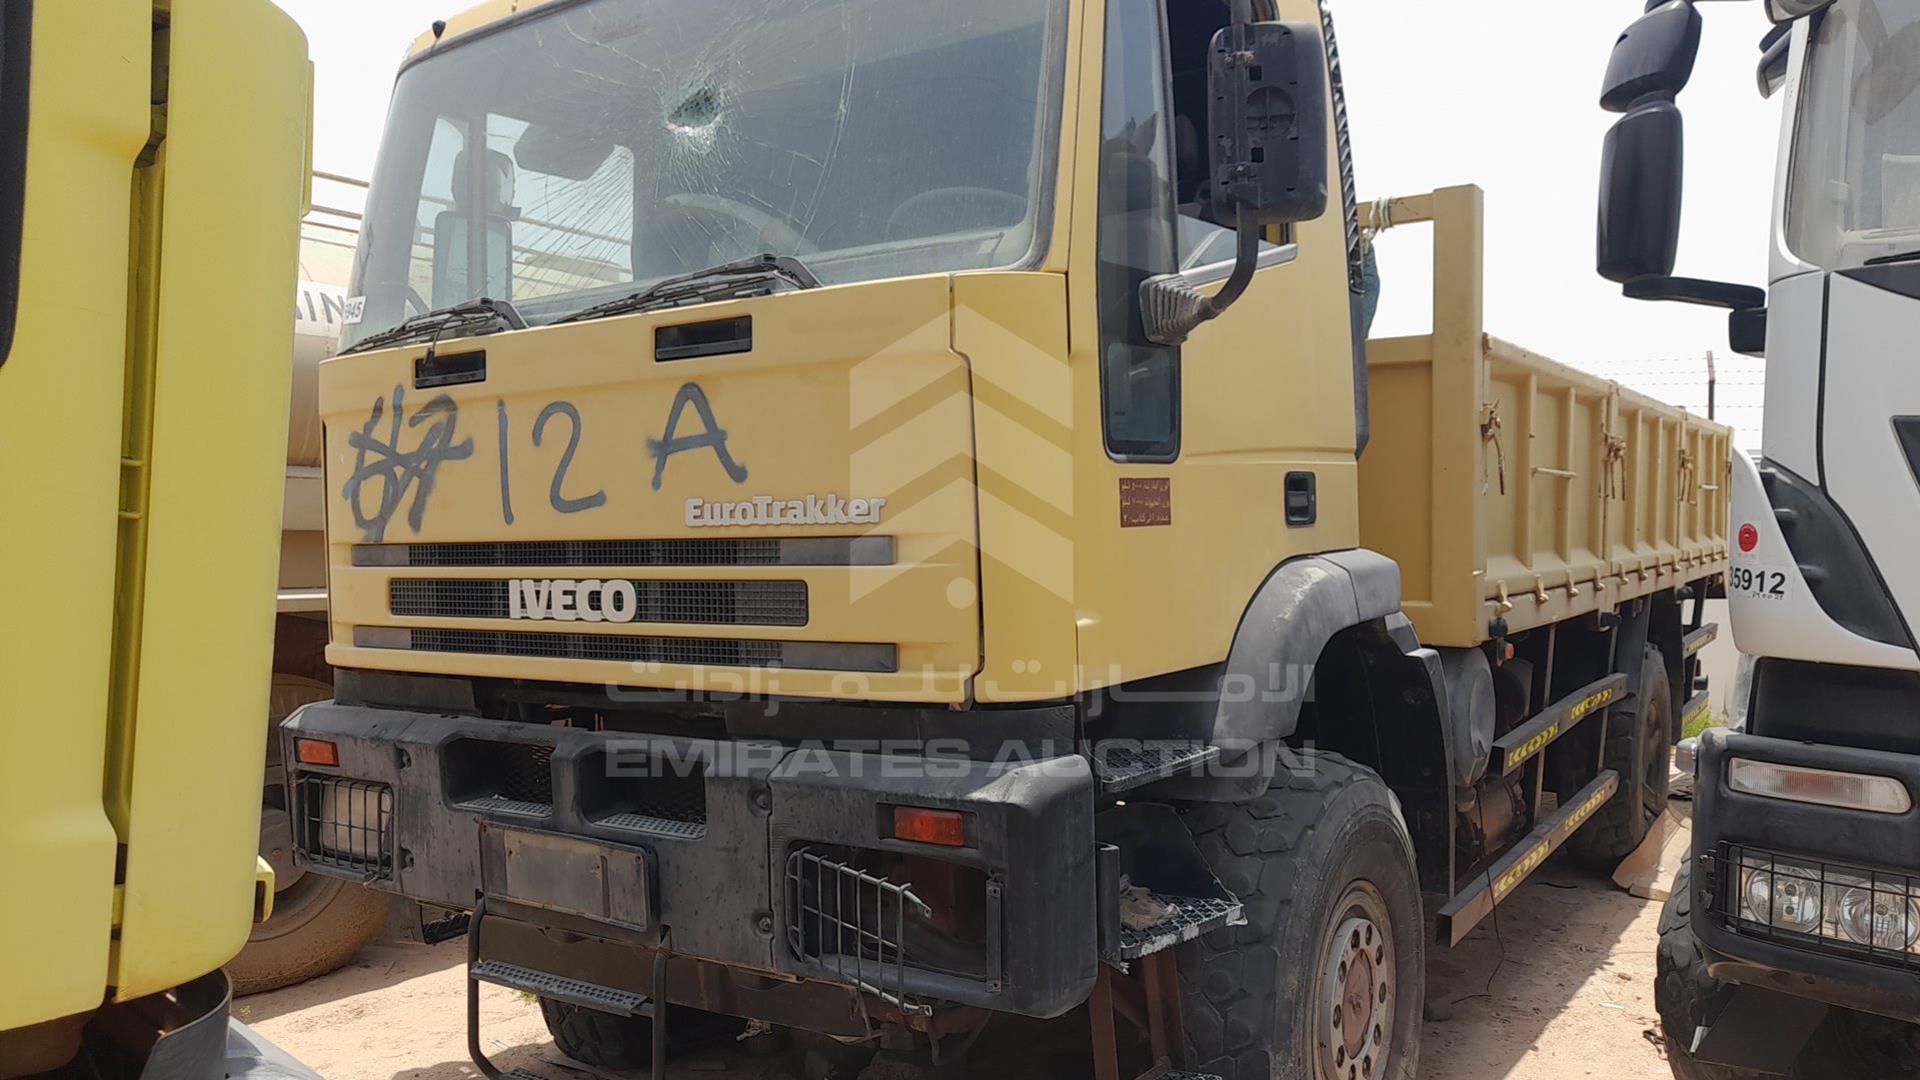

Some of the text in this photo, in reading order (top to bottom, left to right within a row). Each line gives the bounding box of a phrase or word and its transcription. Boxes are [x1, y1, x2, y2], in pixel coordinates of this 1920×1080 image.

[647, 382, 749, 491] A
[684, 494, 886, 526] EuroTrakker
[508, 579, 637, 623] IVECO
